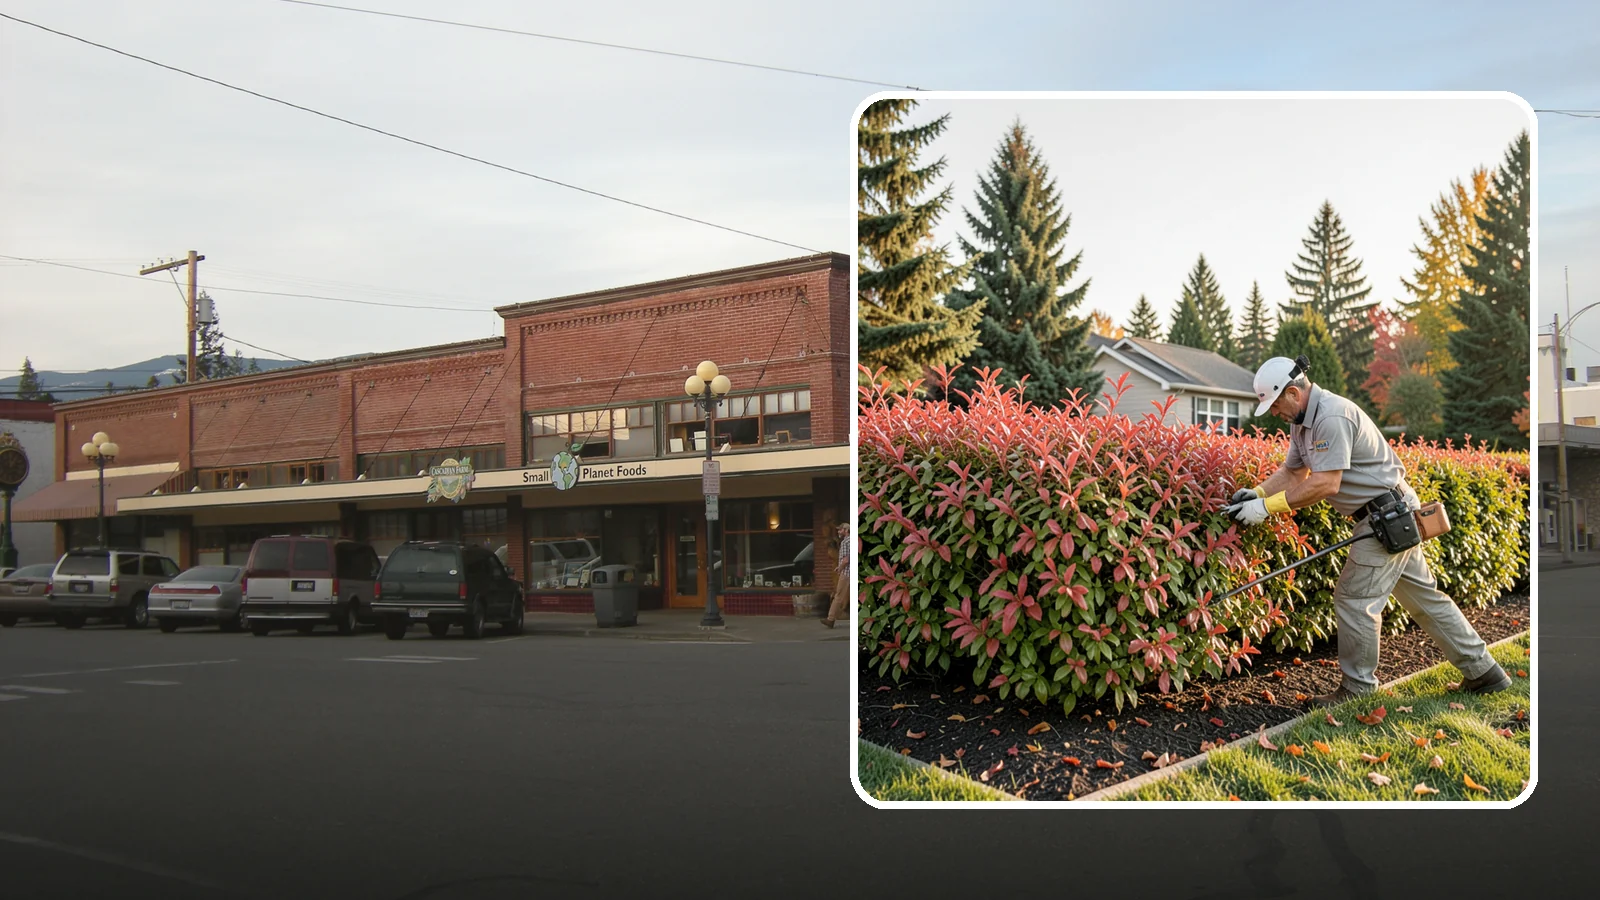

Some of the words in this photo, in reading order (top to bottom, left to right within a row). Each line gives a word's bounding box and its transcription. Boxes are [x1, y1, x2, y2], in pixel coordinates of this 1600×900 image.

[523, 471, 549, 482] Small
[582, 467, 614, 479] Planet
[616, 464, 647, 476] Foods
